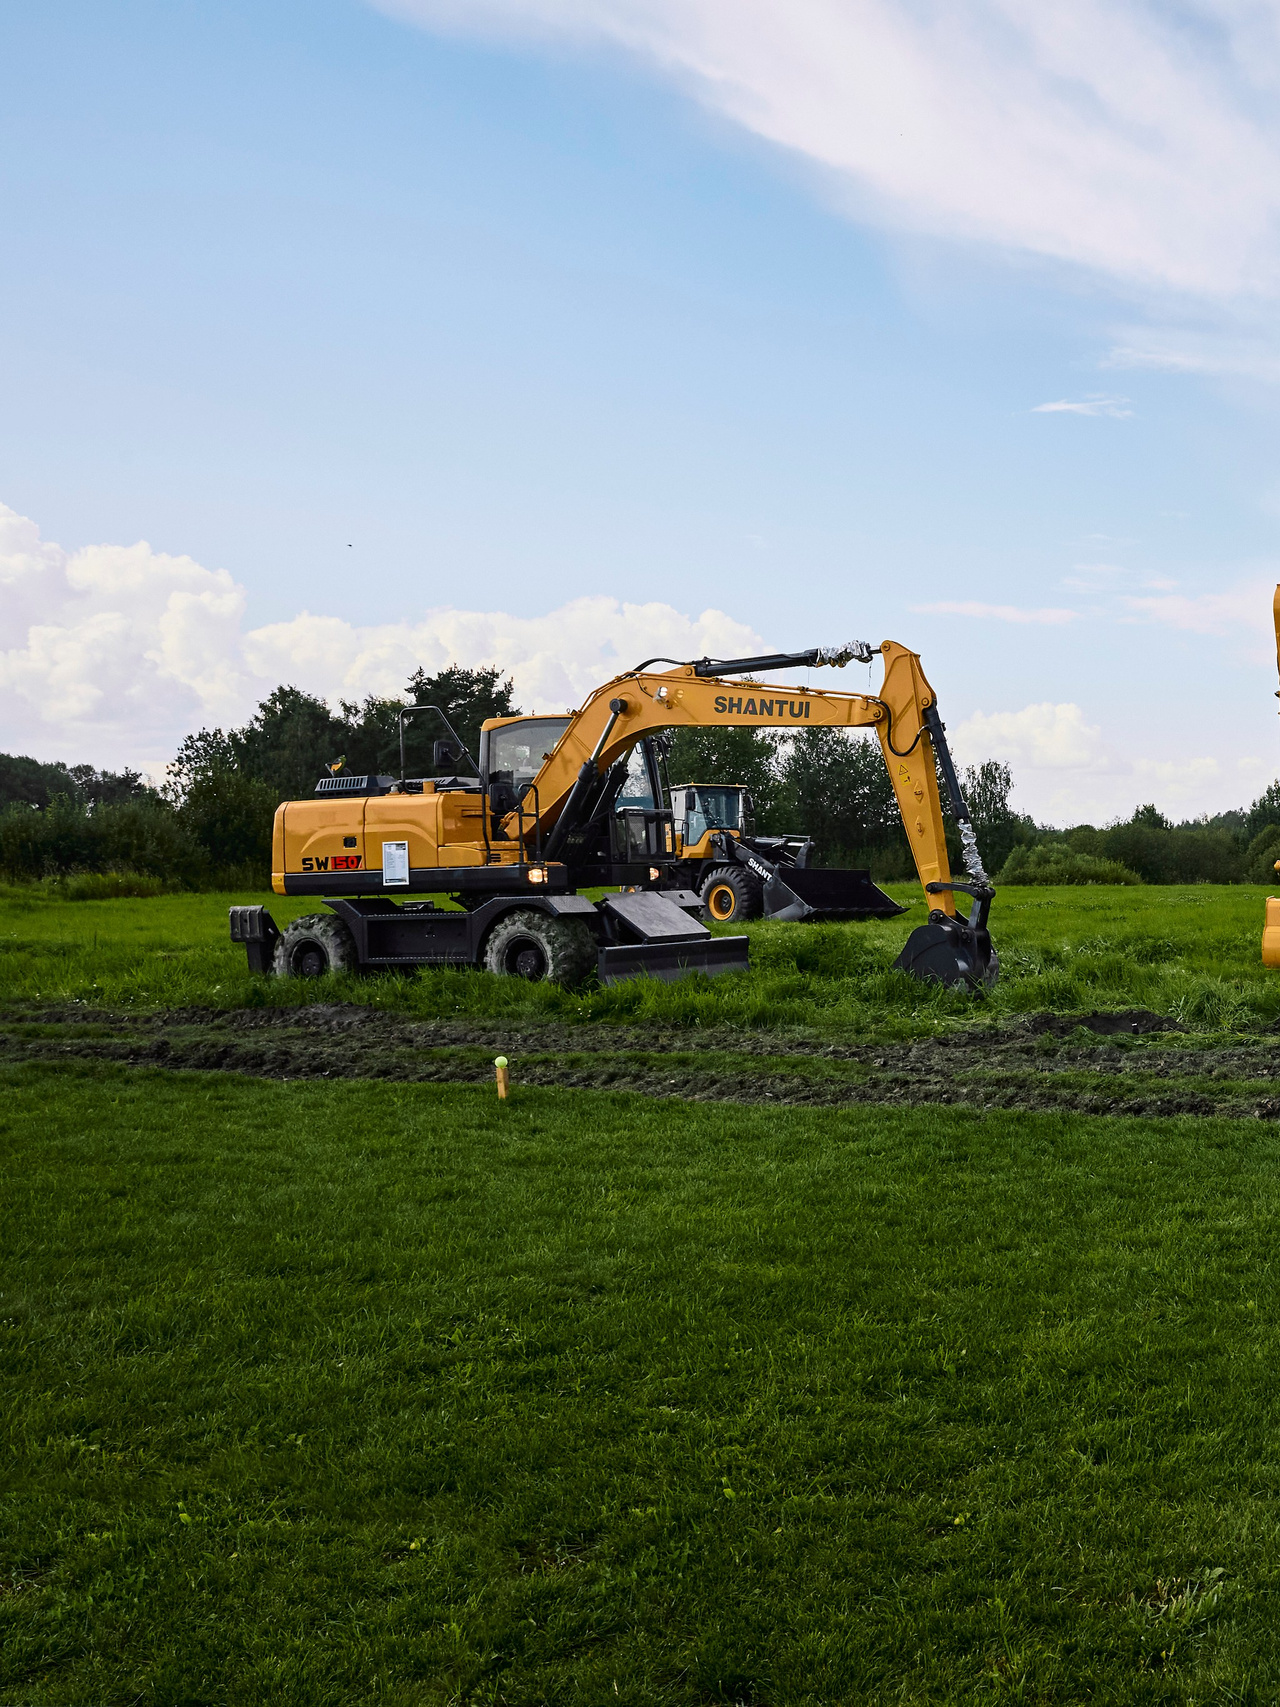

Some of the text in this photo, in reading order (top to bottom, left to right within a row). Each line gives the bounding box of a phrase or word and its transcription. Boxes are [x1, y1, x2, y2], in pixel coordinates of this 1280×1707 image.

[714, 696, 811, 719] SHANTUI
[302, 856, 358, 871] SW150
[747, 858, 773, 881] SHANT
